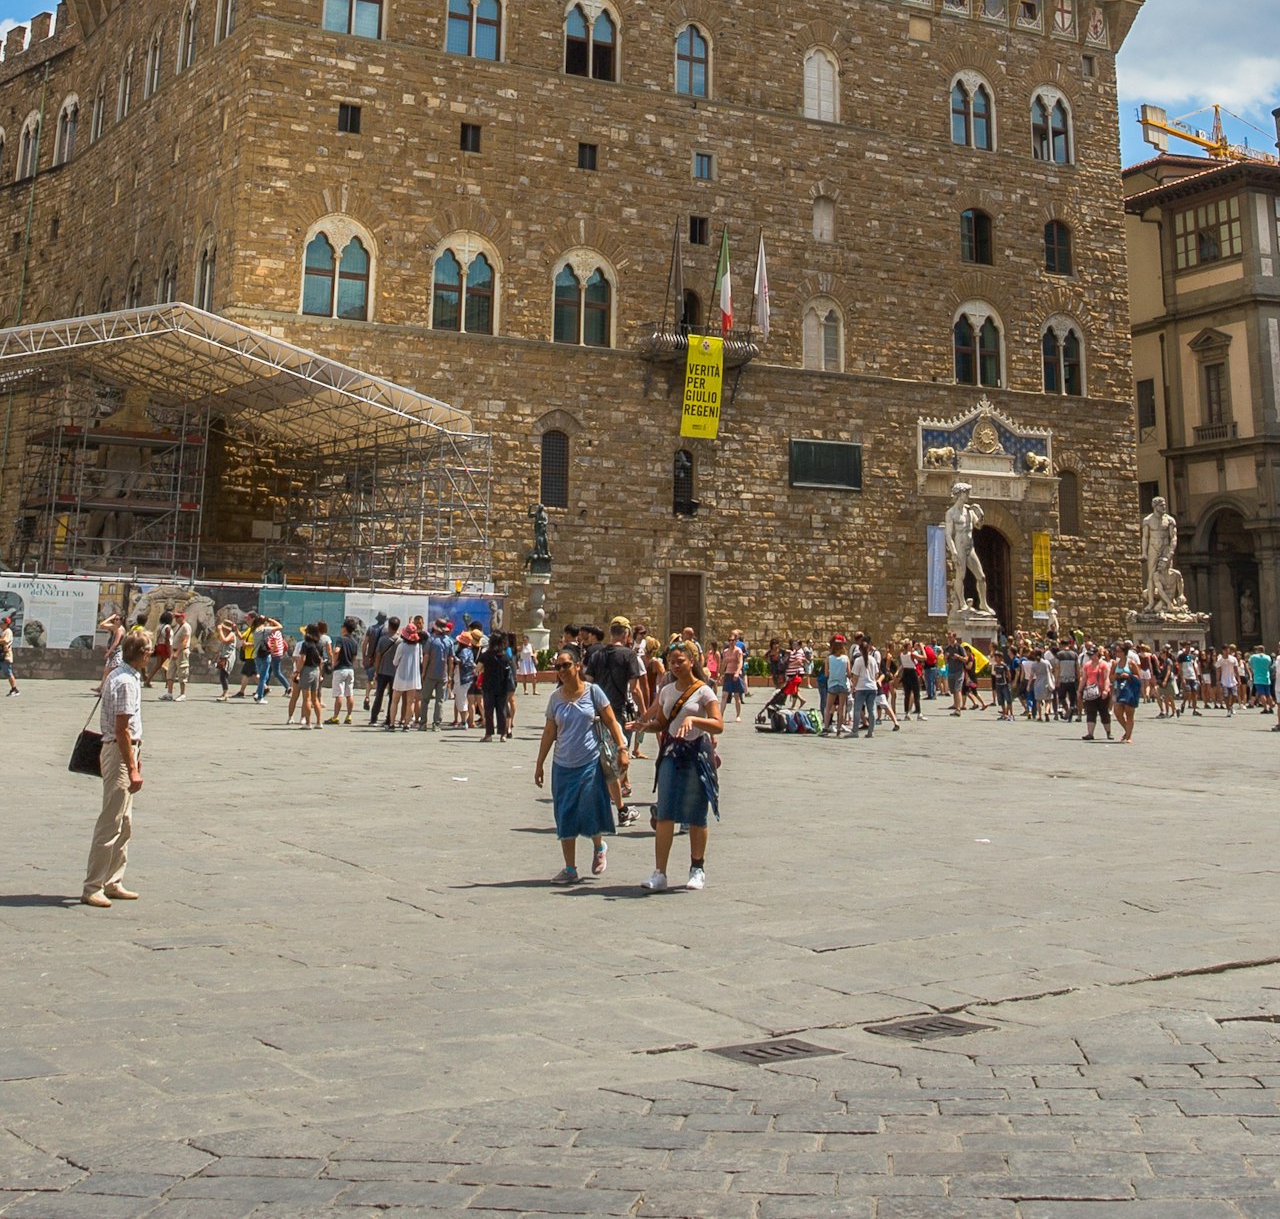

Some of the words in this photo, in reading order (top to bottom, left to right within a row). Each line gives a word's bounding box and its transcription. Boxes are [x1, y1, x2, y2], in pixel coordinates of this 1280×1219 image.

[689, 363, 720, 378] VERITÀ
[687, 377, 706, 389] PER
[685, 390, 717, 403] GIULIO
[684, 403, 719, 418] REGENI
[6, 581, 17, 589] La
[17, 582, 58, 590] FONTANA
[30, 588, 42, 596] del
[43, 589, 84, 597] NETTUNO
